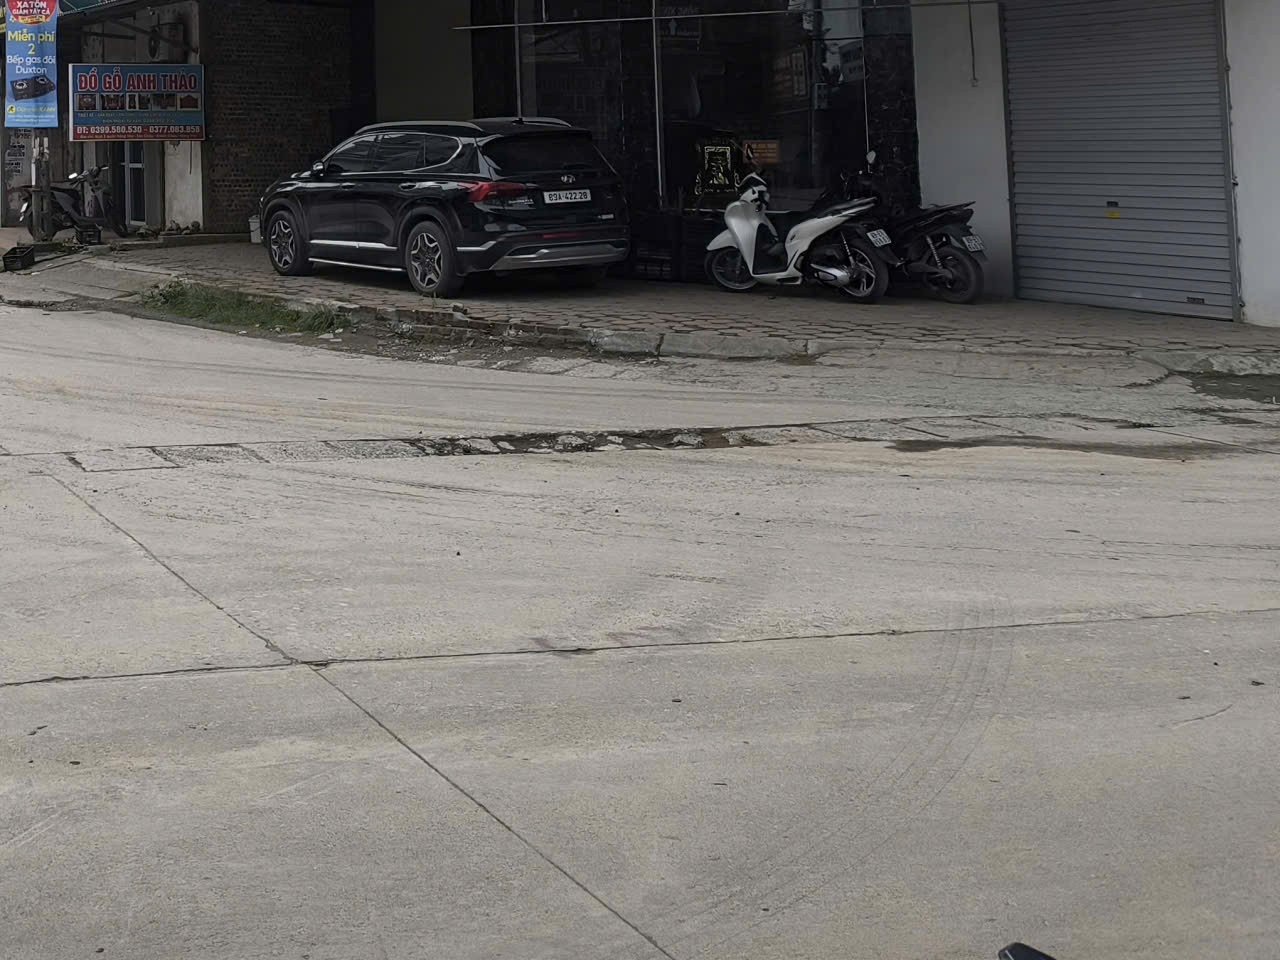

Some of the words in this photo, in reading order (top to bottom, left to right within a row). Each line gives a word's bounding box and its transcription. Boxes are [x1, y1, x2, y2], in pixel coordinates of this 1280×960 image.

[7, 28, 35, 41] Miễn
[38, 30, 55, 44] phí
[27, 43, 36, 55] 2
[6, 55, 24, 66] Bếp
[25, 58, 41, 66] gas
[42, 55, 56, 64] đôi
[15, 65, 48, 74] Duxton
[102, 66, 123, 91] GỖ
[126, 72, 157, 92] ANH
[160, 68, 199, 92] THẢO
